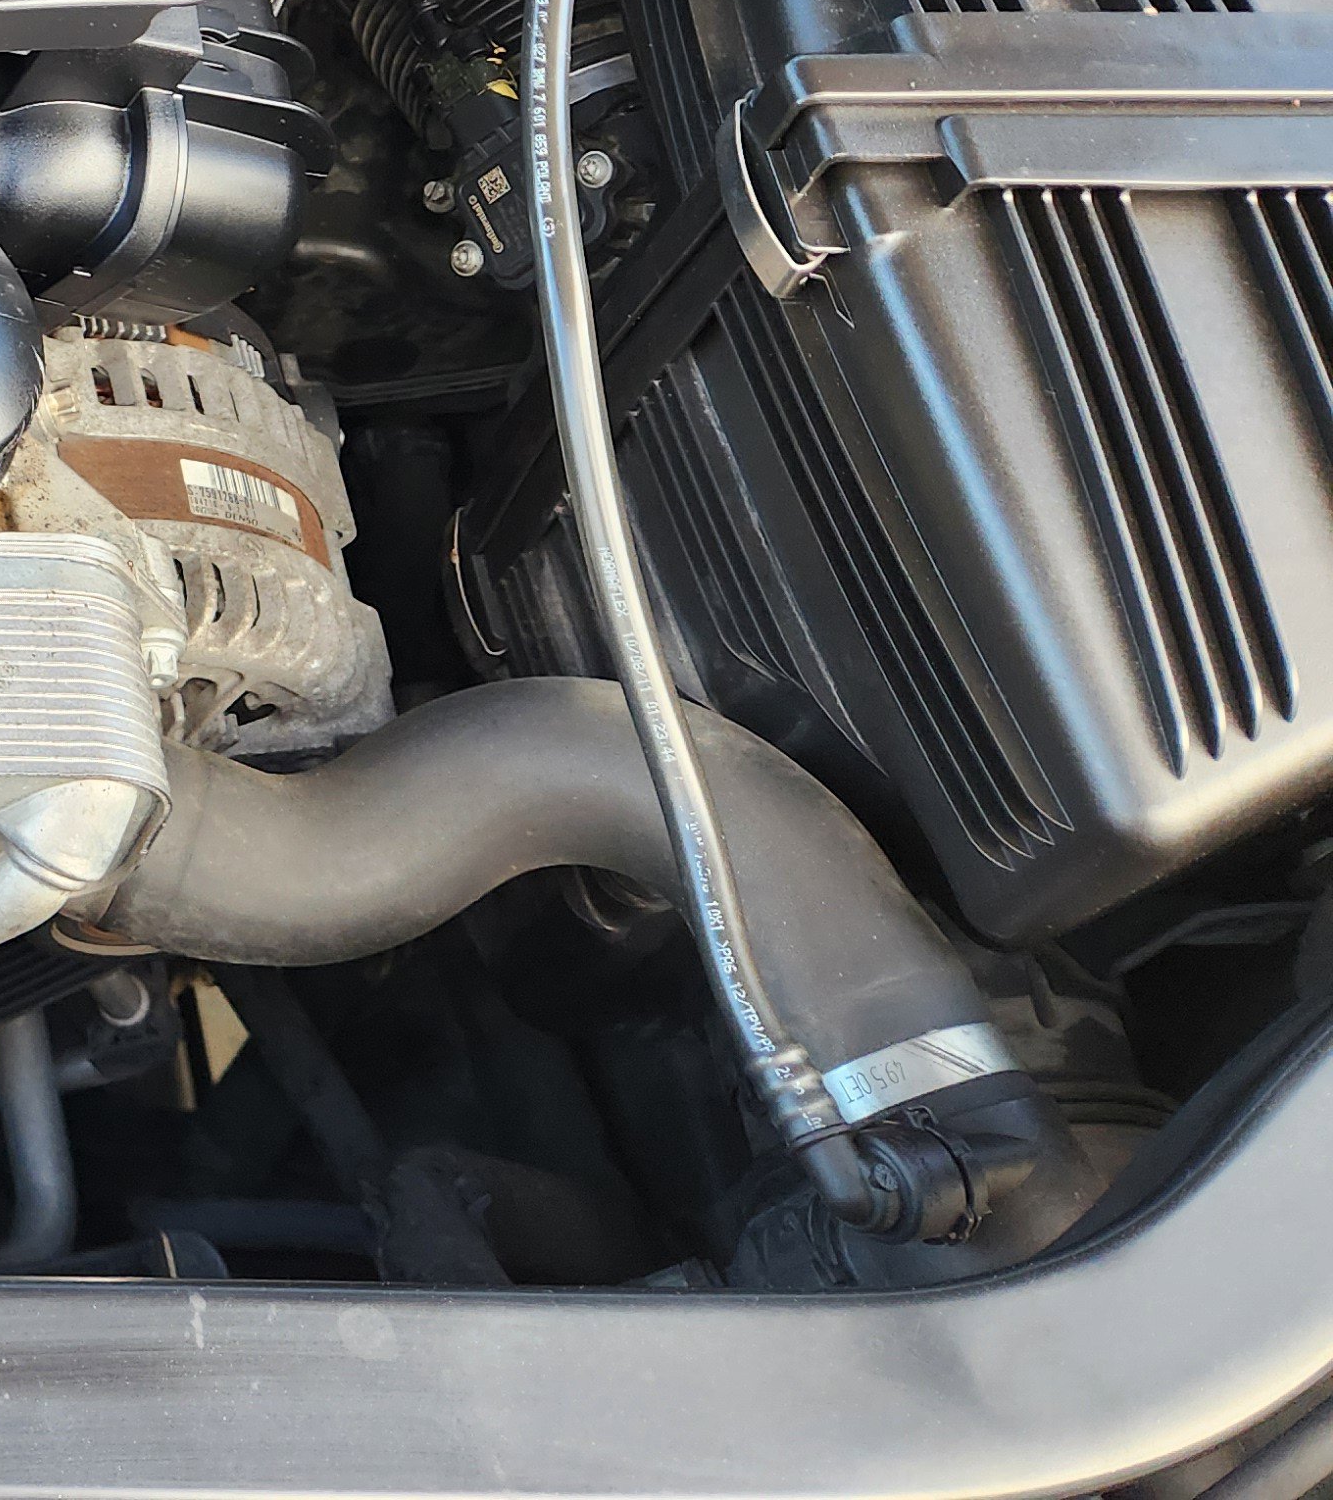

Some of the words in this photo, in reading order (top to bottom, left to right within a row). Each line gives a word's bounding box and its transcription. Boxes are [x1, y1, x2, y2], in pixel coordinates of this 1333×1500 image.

[533, 92, 547, 101] 7
[532, 106, 548, 128] 601
[534, 133, 550, 156] 859
[225, 510, 259, 527] DENSO
[622, 632, 654, 692] 10/08/11
